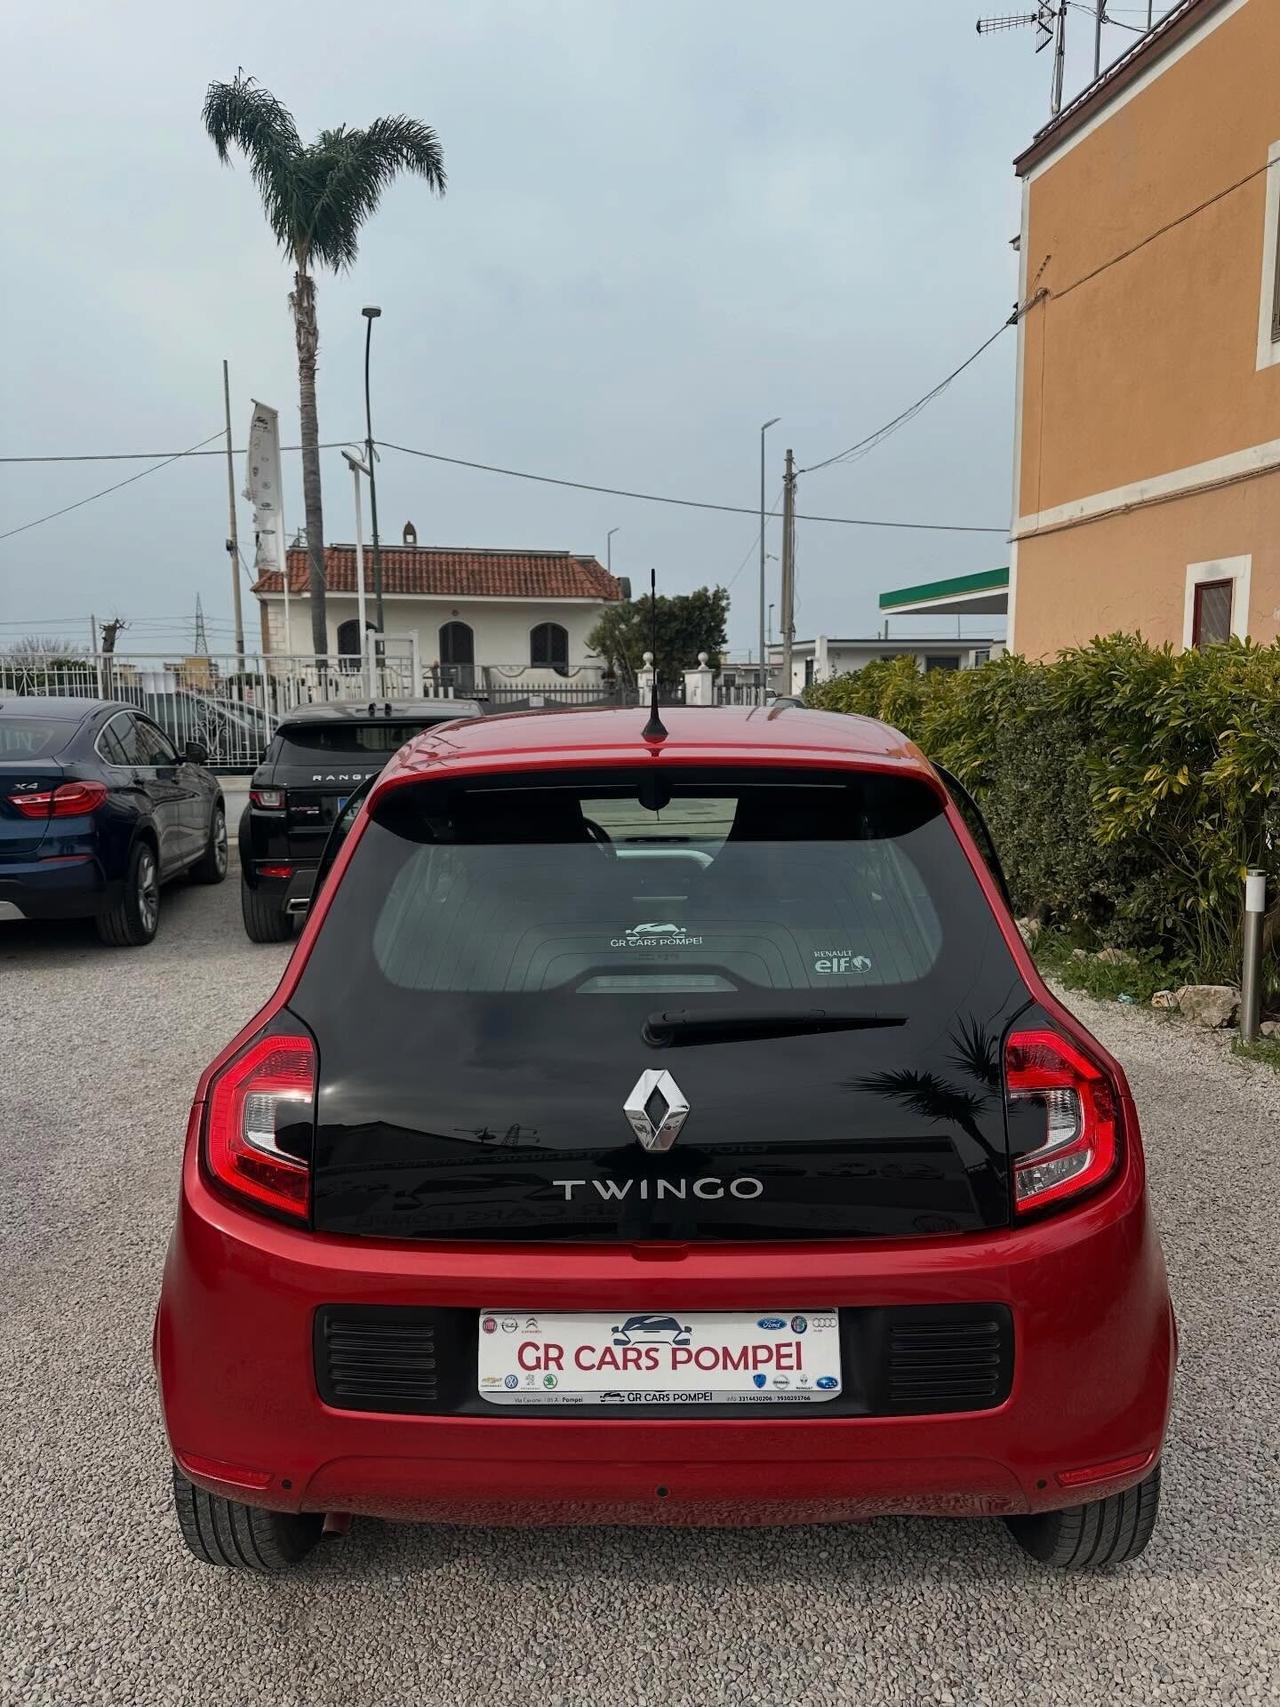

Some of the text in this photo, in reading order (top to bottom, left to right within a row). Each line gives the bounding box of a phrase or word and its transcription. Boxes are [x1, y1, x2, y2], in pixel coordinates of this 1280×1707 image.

[13, 782, 39, 790] X4
[610, 937, 703, 947] GR CARS POMPEI
[814, 950, 852, 958] RENAULT
[814, 958, 851, 973] elf
[552, 1177, 764, 1200] TWINGO
[517, 1341, 802, 1371] GR CARS POMPEI
[627, 1392, 713, 1402] GR CARS POMPEI
